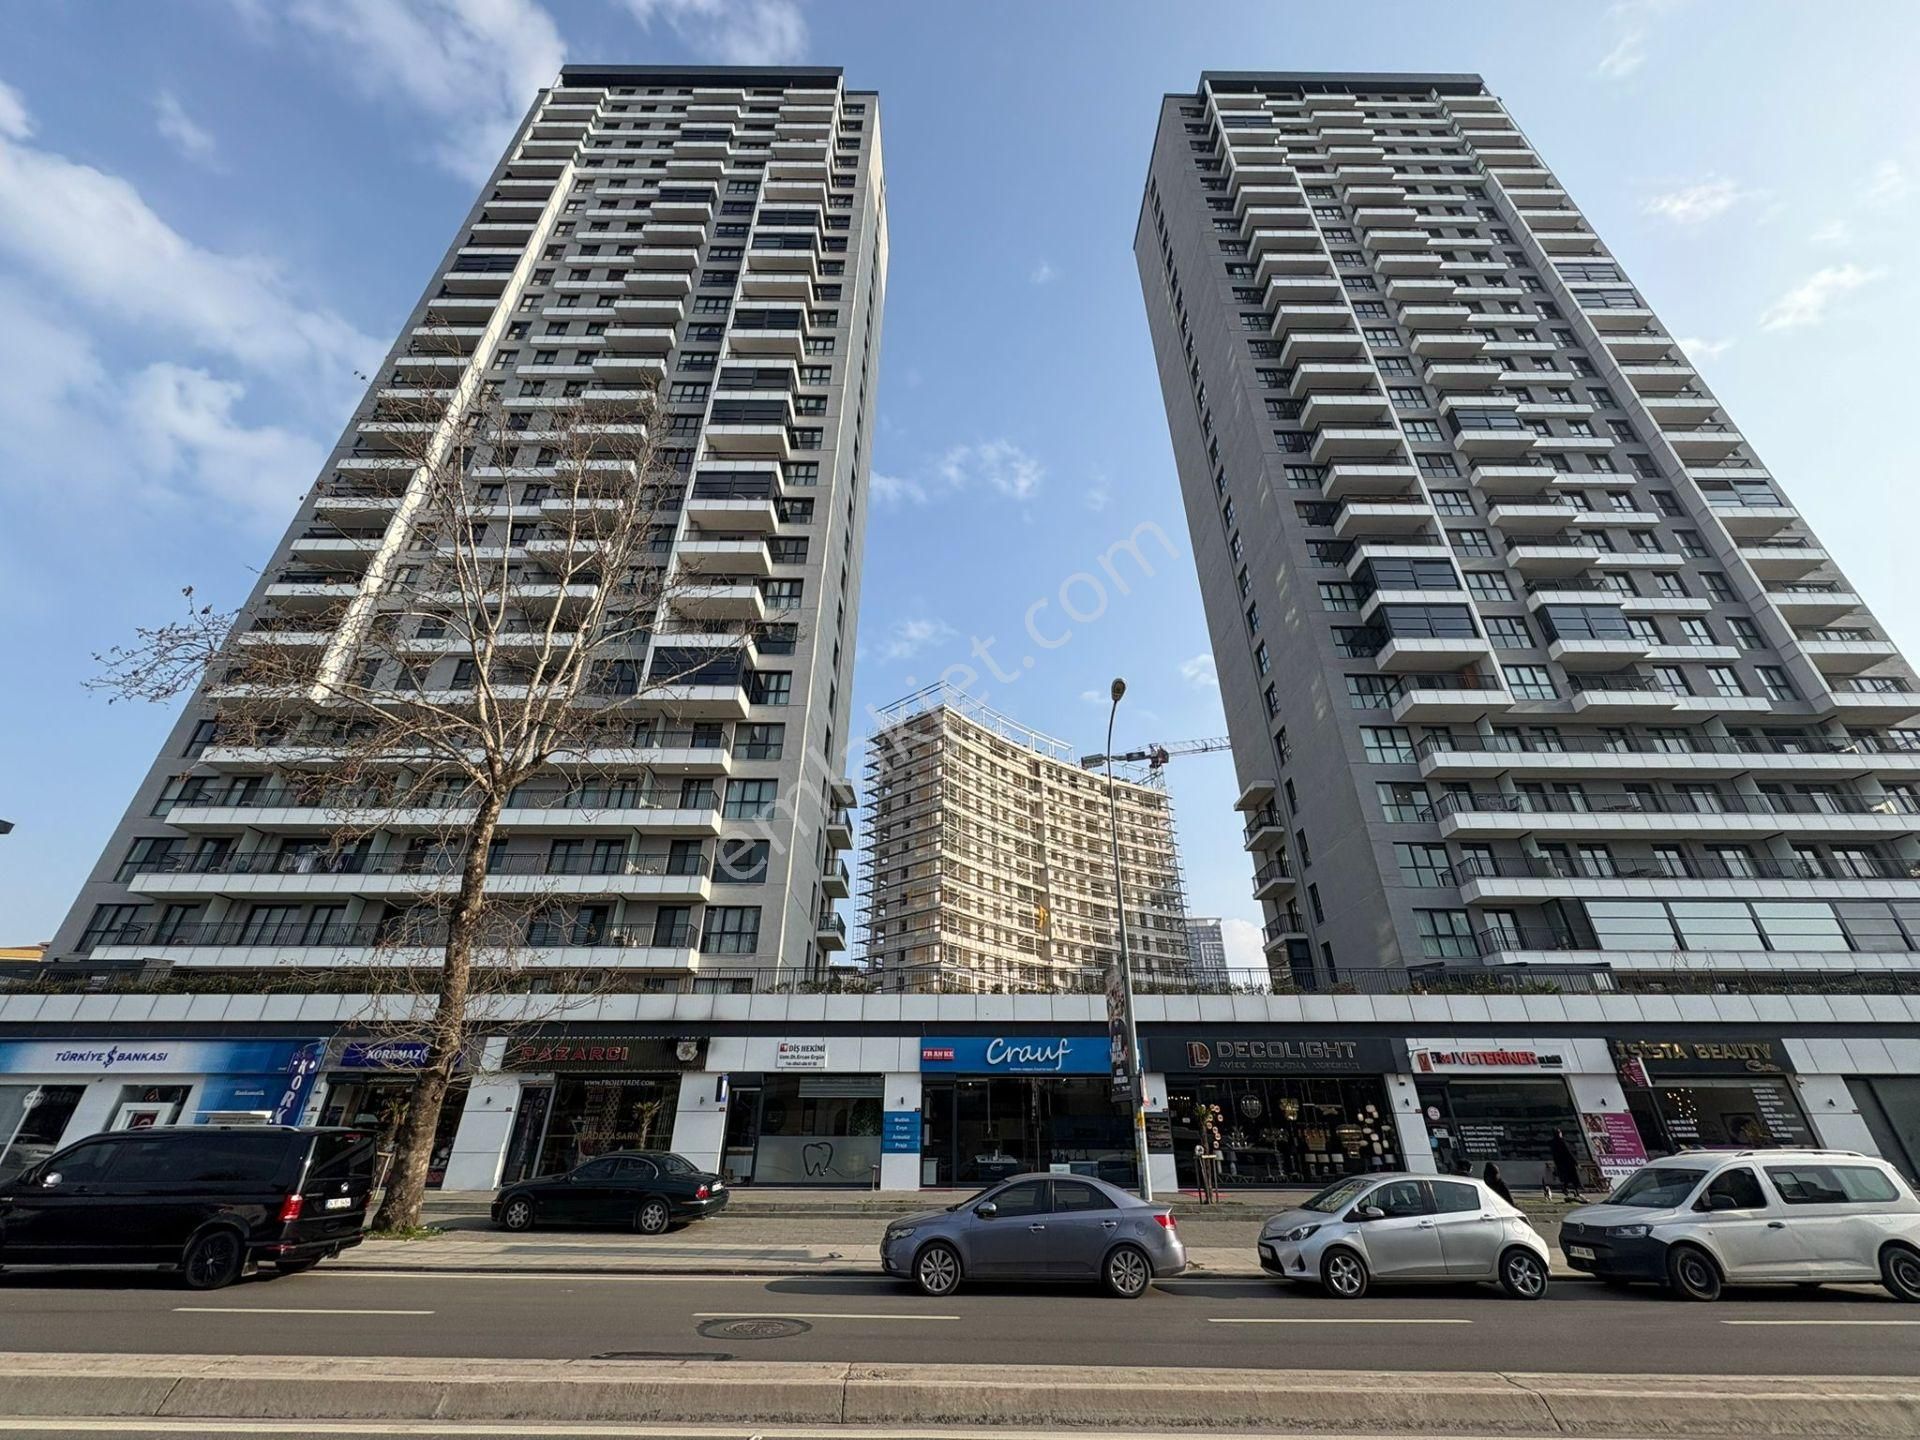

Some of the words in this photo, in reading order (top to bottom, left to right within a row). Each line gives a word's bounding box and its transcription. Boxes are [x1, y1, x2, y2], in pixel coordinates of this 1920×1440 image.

[366, 1049, 422, 1060] KORKMAZ
[520, 1046, 630, 1062] PAZARCI
[789, 1044, 800, 1053] DİŞ
[801, 1044, 826, 1053] HEKİMİ
[987, 1038, 1072, 1070] Crauf
[1217, 1041, 1357, 1058] DECOLIGHT
[1693, 1043, 1772, 1060] BEAUTY
[55, 1051, 105, 1062] TÜRKİYE
[116, 1053, 168, 1062] BANKASI
[1457, 1051, 1537, 1065] VETERİNER
[1616, 1157, 1647, 1167] KUAFÖR
